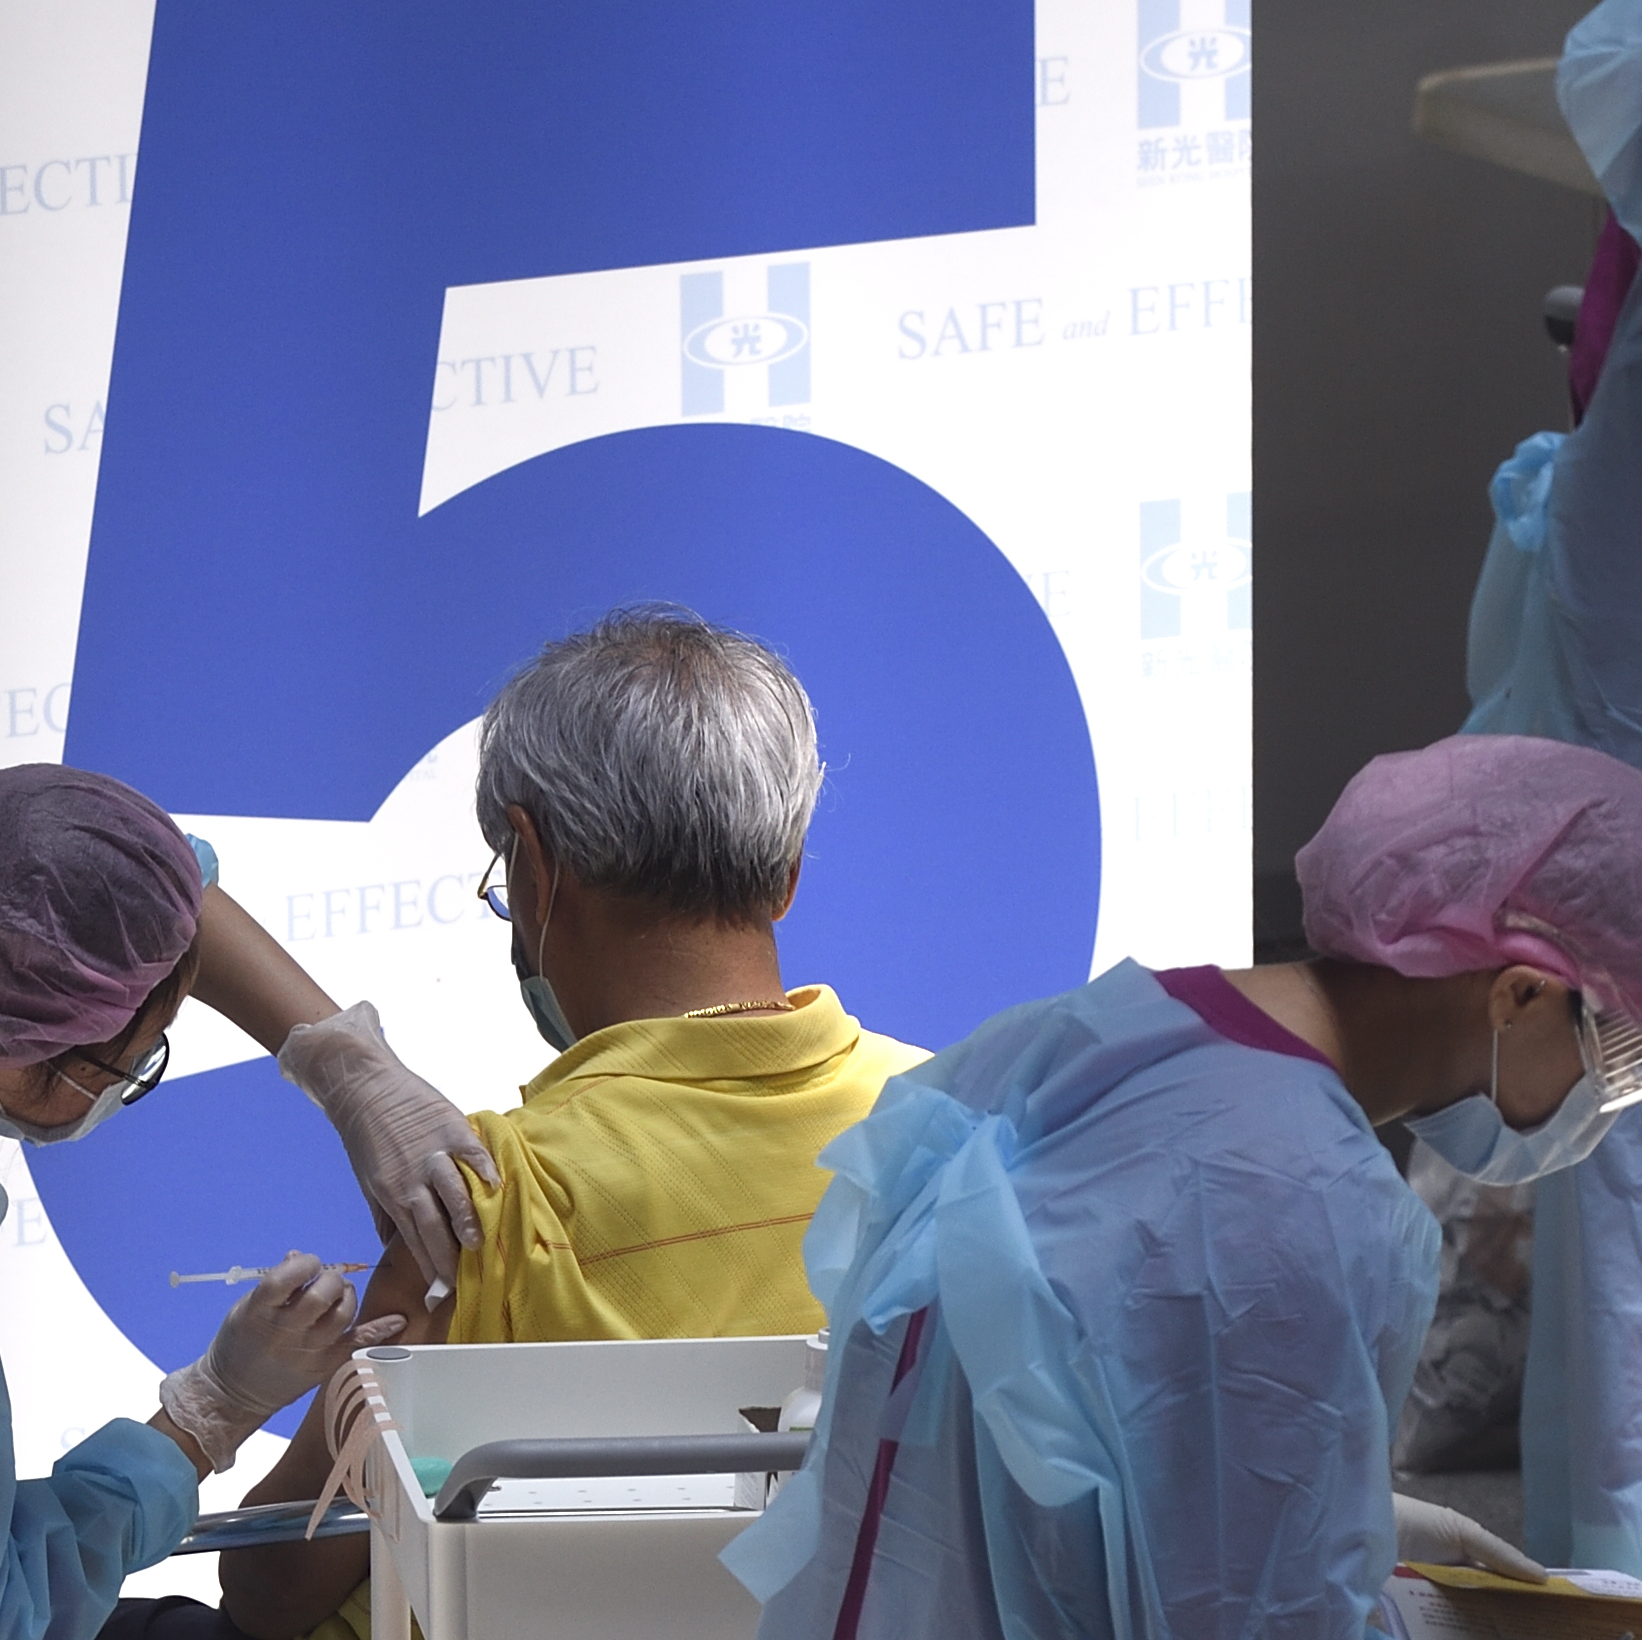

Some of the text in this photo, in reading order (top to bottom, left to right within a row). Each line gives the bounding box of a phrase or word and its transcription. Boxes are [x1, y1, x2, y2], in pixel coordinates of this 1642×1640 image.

[897, 297, 1046, 361] SAFE
[1062, 310, 1110, 341] and
[17, 0, 1104, 1442] 5
